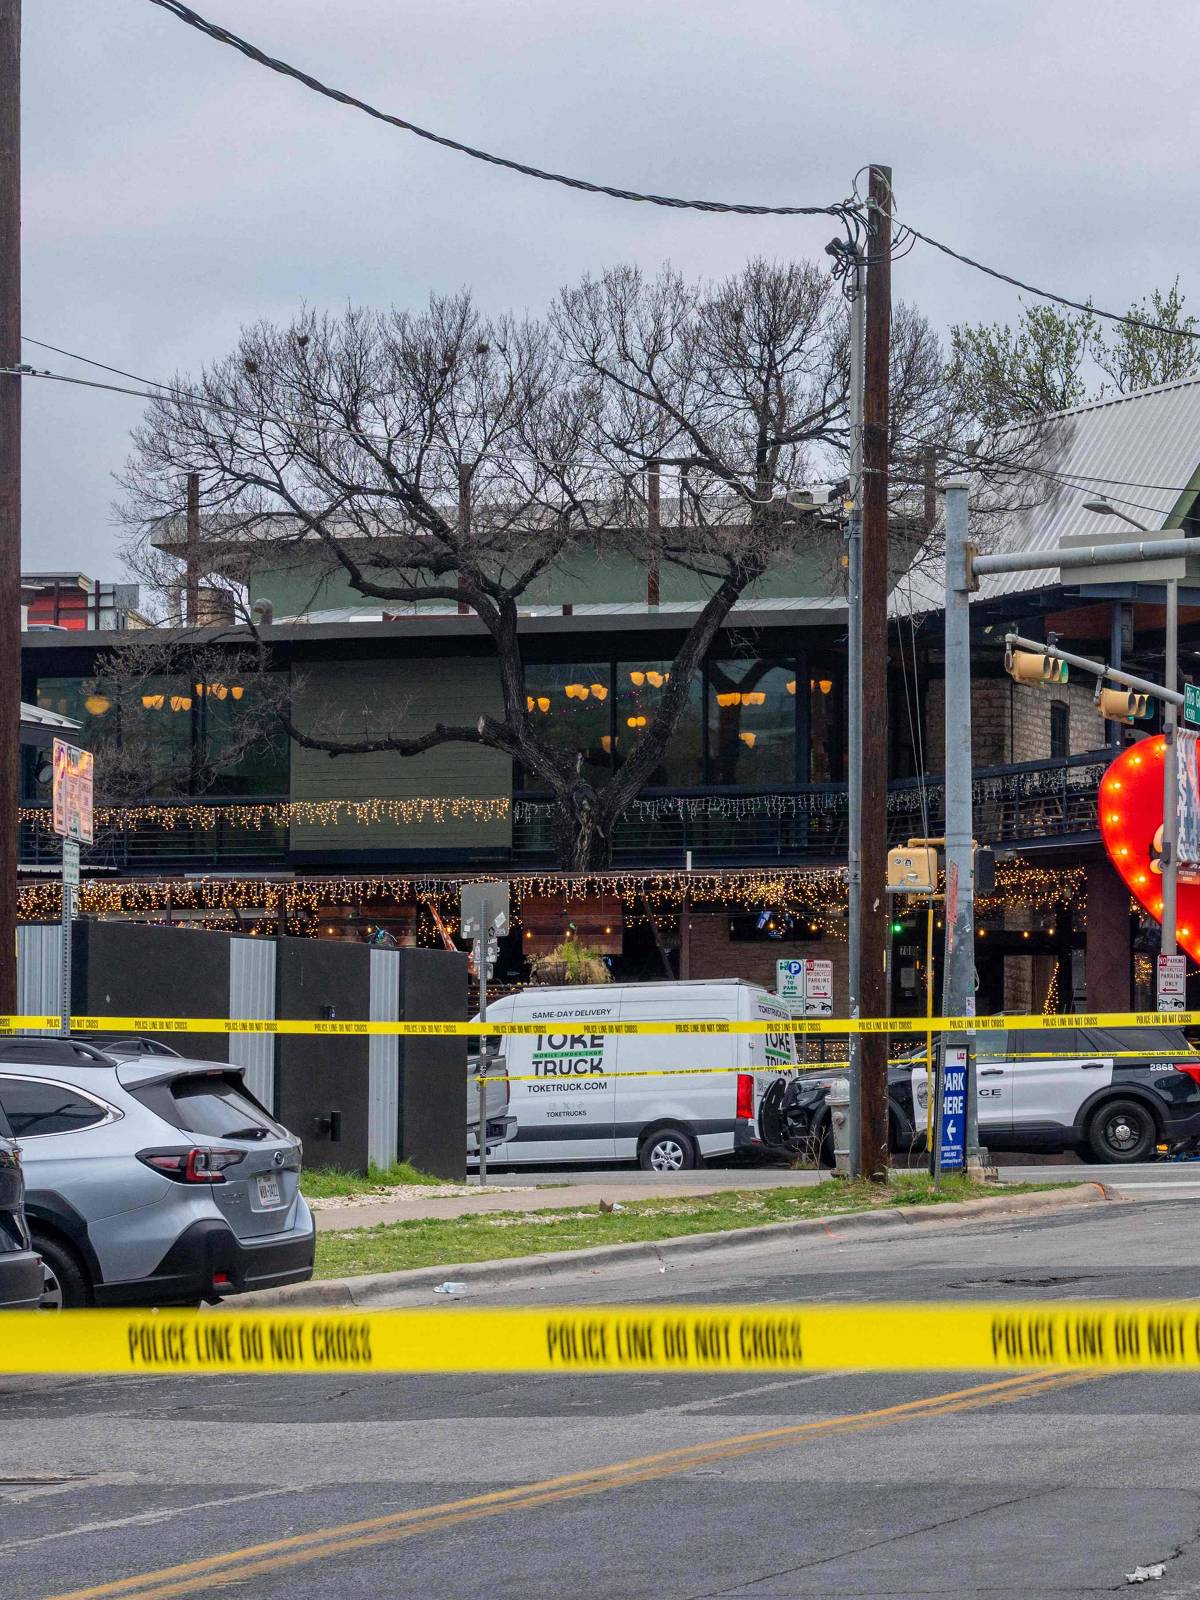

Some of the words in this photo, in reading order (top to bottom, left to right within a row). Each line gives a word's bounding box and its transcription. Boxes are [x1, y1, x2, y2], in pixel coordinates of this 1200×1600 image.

[1187, 686, 1195, 705] Rio
[532, 1011, 573, 1019] SAME-DAY
[575, 1008, 612, 1017] DELIVERY
[1136, 1015, 1150, 1024] POLICE
[1178, 1014, 1192, 1023] CROSS
[134, 1020, 147, 1029] POLICE
[174, 1021, 187, 1030] CROSS
[675, 1024, 689, 1033] POLICE
[716, 1024, 729, 1032] CROSS
[859, 1021, 872, 1030] POLICE
[899, 1021, 912, 1030] CROSS
[531, 1058, 604, 1076] TRUCK
[1150, 1063, 1174, 1071] 2868
[527, 1082, 607, 1093] TOKETRUCK.COM
[546, 1110, 587, 1118] TOKETRUCKS
[127, 1321, 190, 1364] POLICE
[194, 1321, 233, 1364] LINE
[239, 1321, 264, 1364] DO
[269, 1321, 304, 1364] NOT
[312, 1321, 371, 1364] CROSS
[547, 1319, 609, 1363] POLICE
[616, 1319, 656, 1363] LINE
[663, 1319, 688, 1363] DO
[694, 1319, 730, 1363] NOT
[739, 1319, 802, 1363] CROSS
[992, 1312, 1057, 1363] POLICE
[1065, 1312, 1106, 1363] LINE
[1114, 1312, 1140, 1363] DO
[1147, 1312, 1185, 1363] NOT
